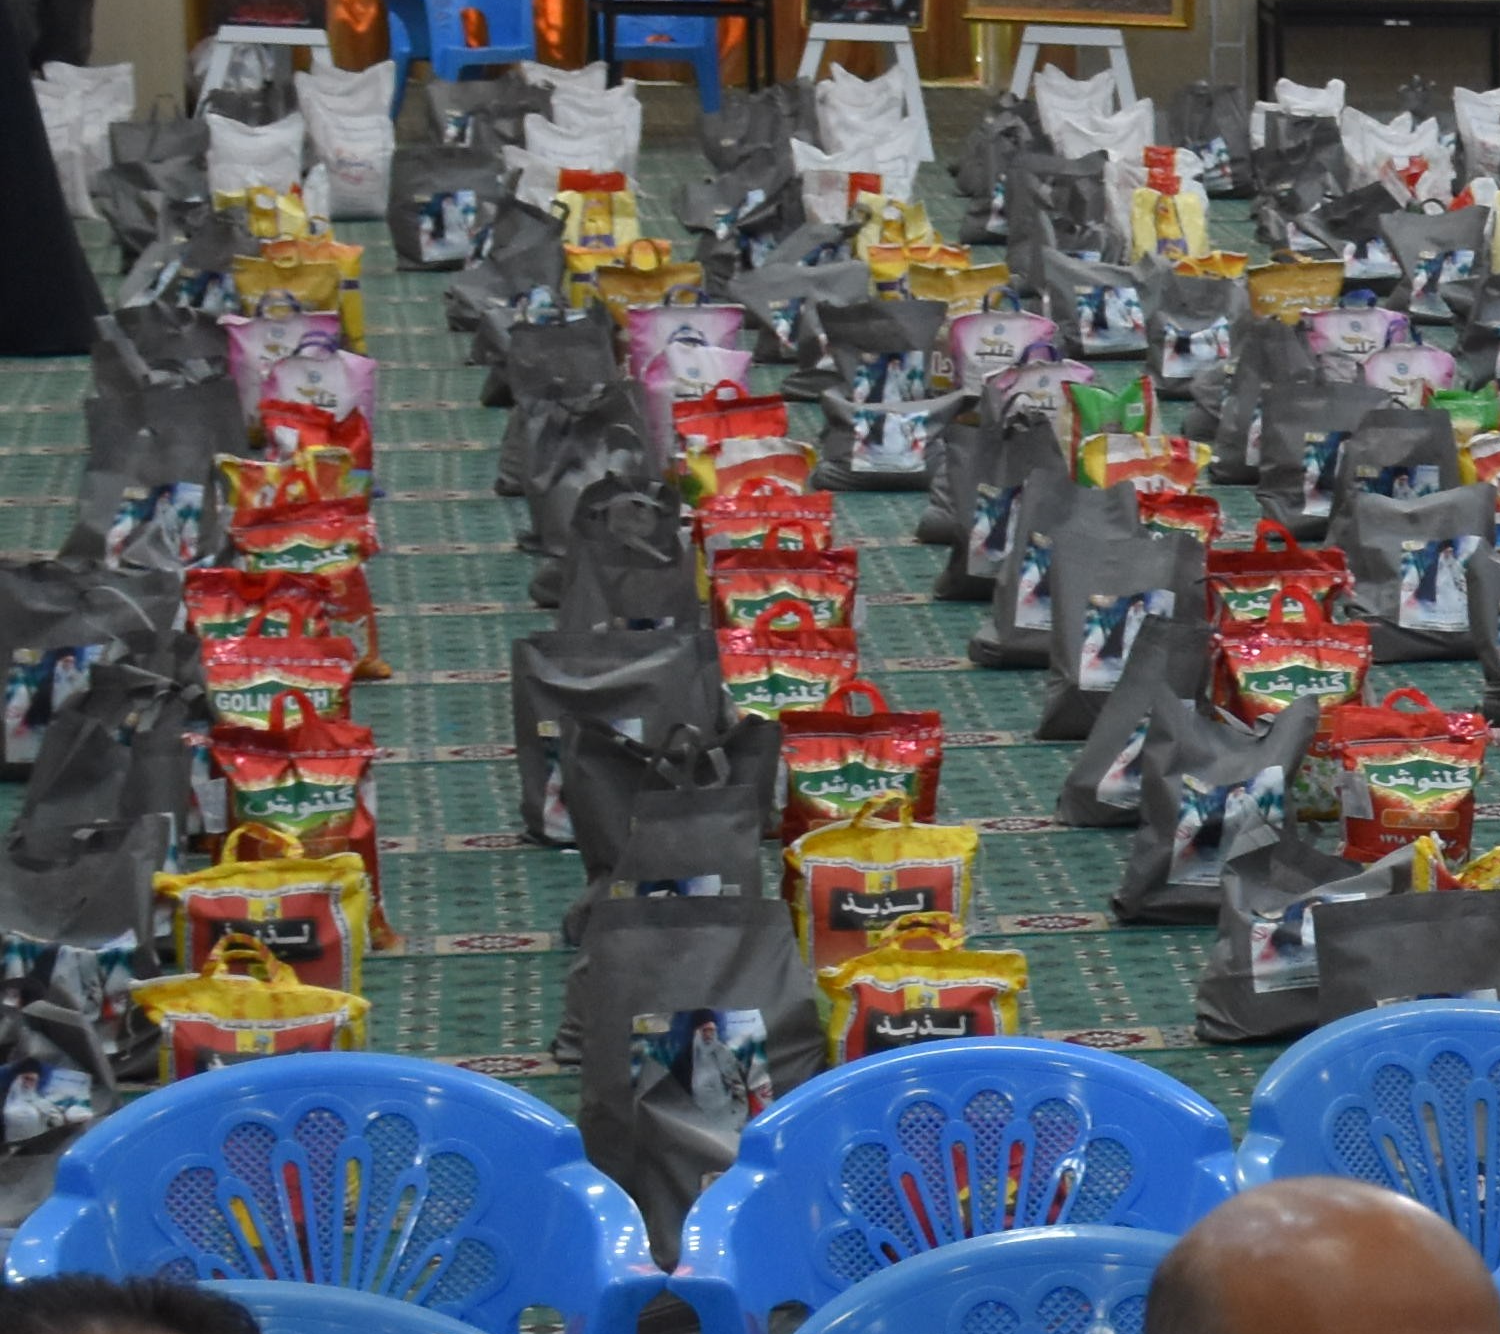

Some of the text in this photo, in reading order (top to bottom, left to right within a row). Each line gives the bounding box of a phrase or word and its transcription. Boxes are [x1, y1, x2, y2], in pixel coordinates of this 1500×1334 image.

[973, 342, 1015, 358] قلب
[1249, 672, 1348, 700] گلنوش
[798, 773, 907, 802] گلنوش
[1369, 767, 1475, 795] گلنوش
[244, 787, 356, 821] گلنوش
[840, 892, 926, 917] لذیذ
[874, 1013, 969, 1038] لذیذ
